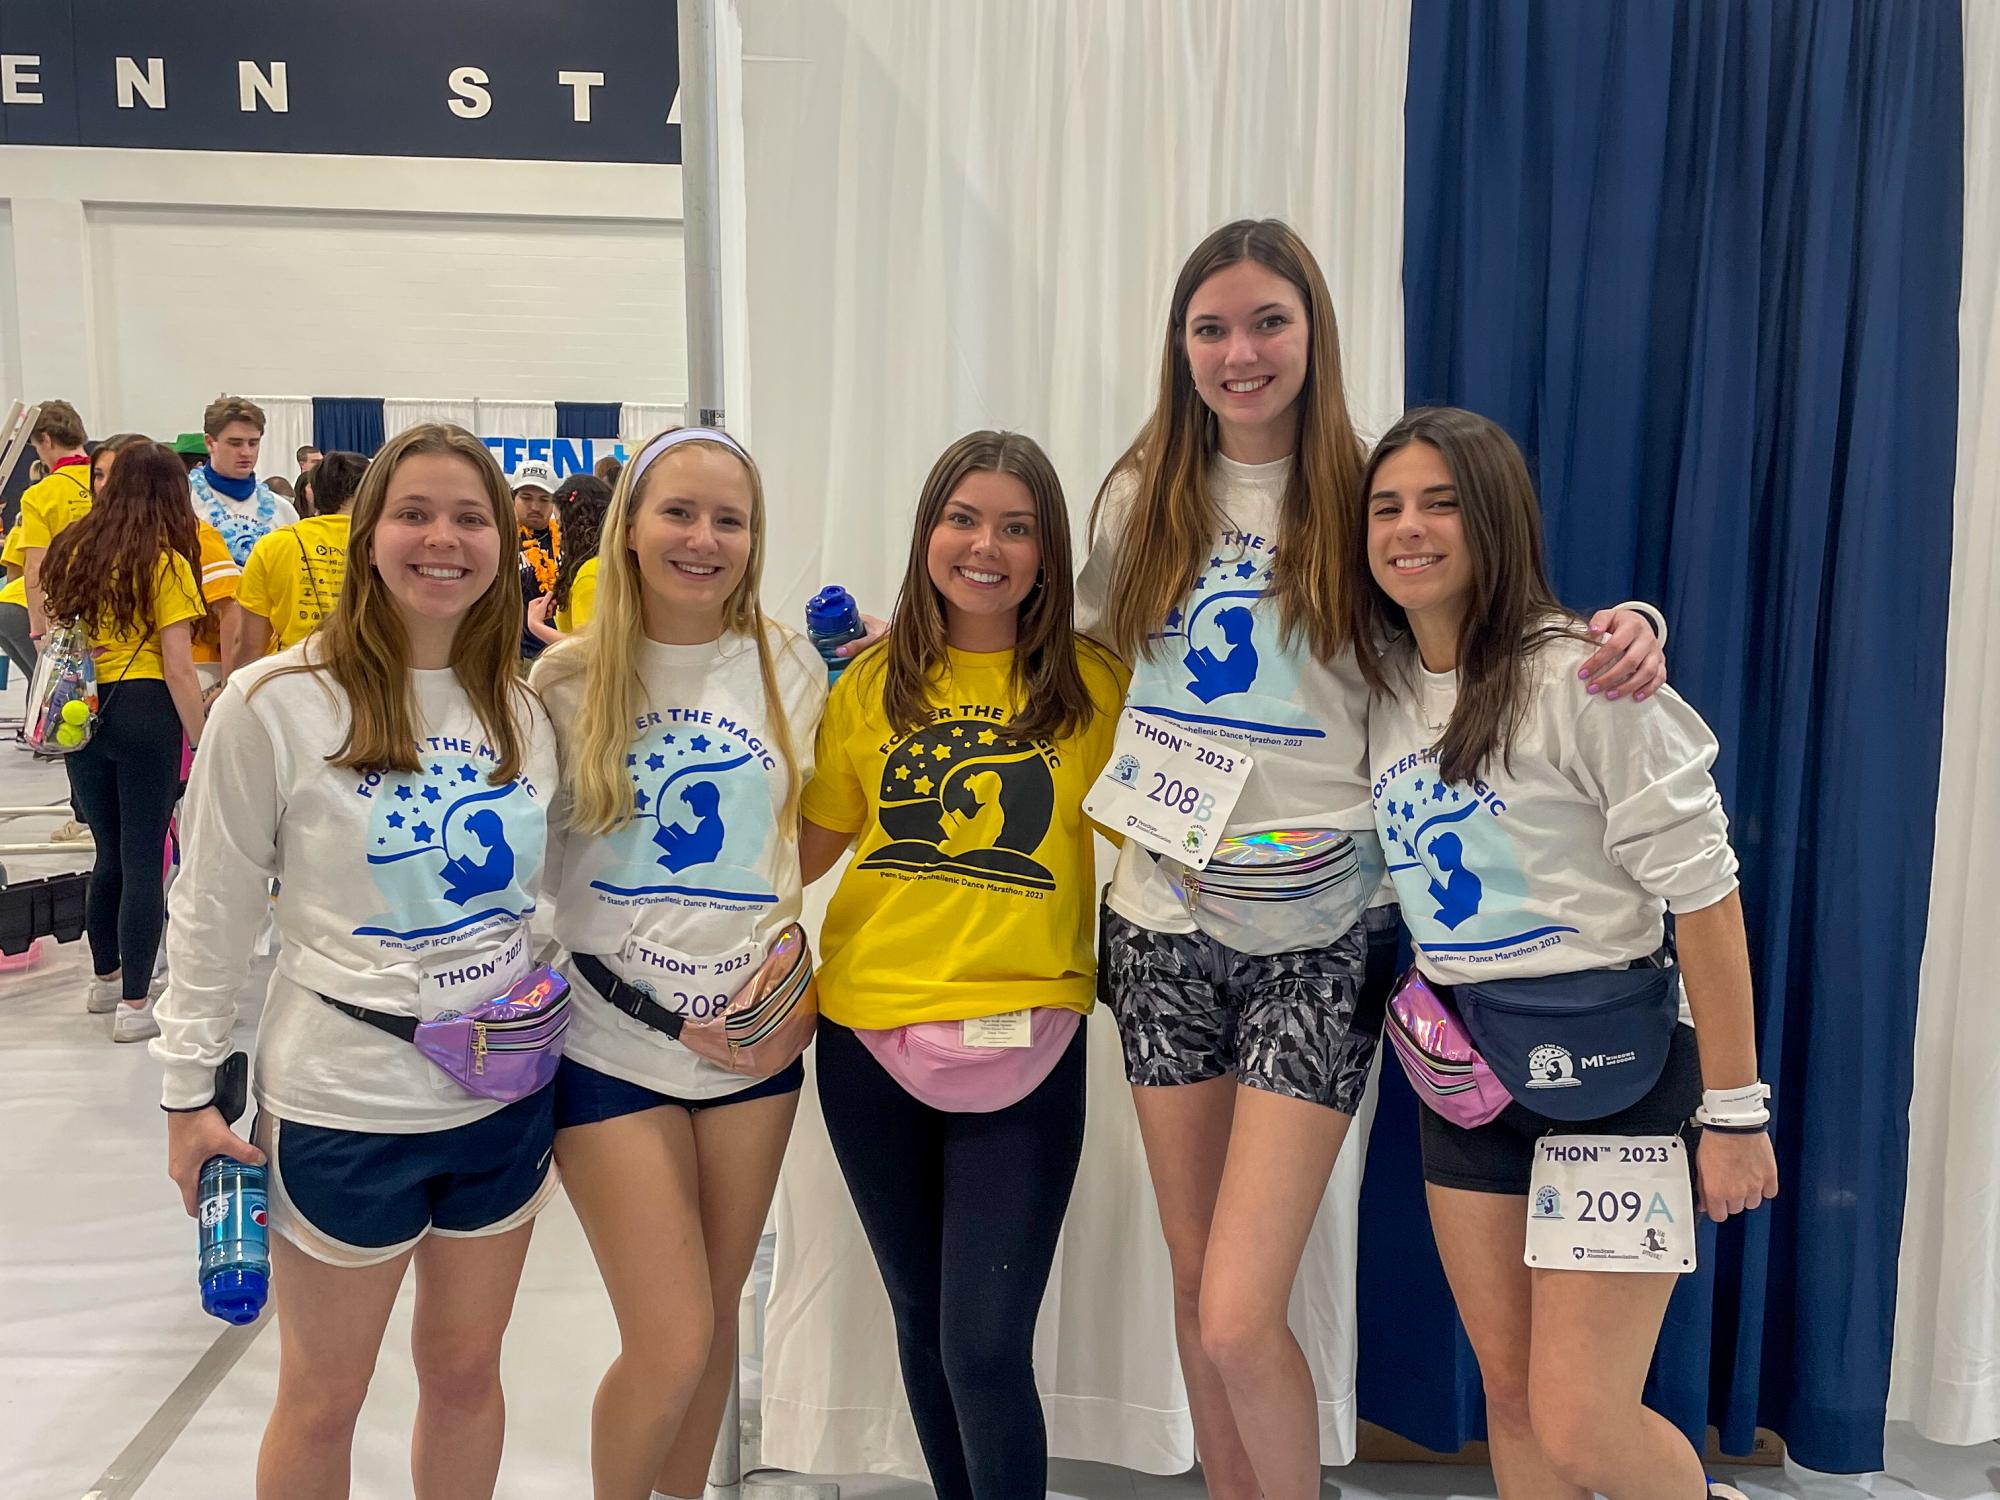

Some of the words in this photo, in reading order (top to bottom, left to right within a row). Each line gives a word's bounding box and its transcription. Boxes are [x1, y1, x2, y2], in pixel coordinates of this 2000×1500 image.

[447, 66, 682, 124] ST
[523, 467, 547, 476] PSU
[1221, 530, 1266, 550] THE
[667, 708, 713, 725] THE
[718, 716, 776, 772] MAGIC
[879, 707, 953, 756] FOER
[959, 704, 1005, 721] THE
[1220, 729, 1244, 740] Dance
[1244, 733, 1281, 746] Marathon
[1283, 739, 1303, 747] 2023
[426, 736, 472, 754] THE
[478, 744, 538, 798] MIC
[1194, 747, 1235, 774] 2023
[1420, 748, 1441, 765] TH
[1146, 772, 1217, 823] 208B
[961, 878, 985, 890] Dance
[986, 883, 1024, 897] Marathon
[1025, 889, 1044, 900] 2023
[683, 899, 707, 908] Dance
[709, 901, 746, 912] Marathon
[380, 939, 403, 950] Penn
[1468, 954, 1494, 964] Dance
[1495, 944, 1538, 961] Marathon
[1540, 935, 1562, 949] 2023
[714, 952, 751, 976] 2023
[673, 992, 729, 1018] 208
[1619, 1147, 1669, 1163] 2023
[1576, 1190, 1675, 1224] 209A
